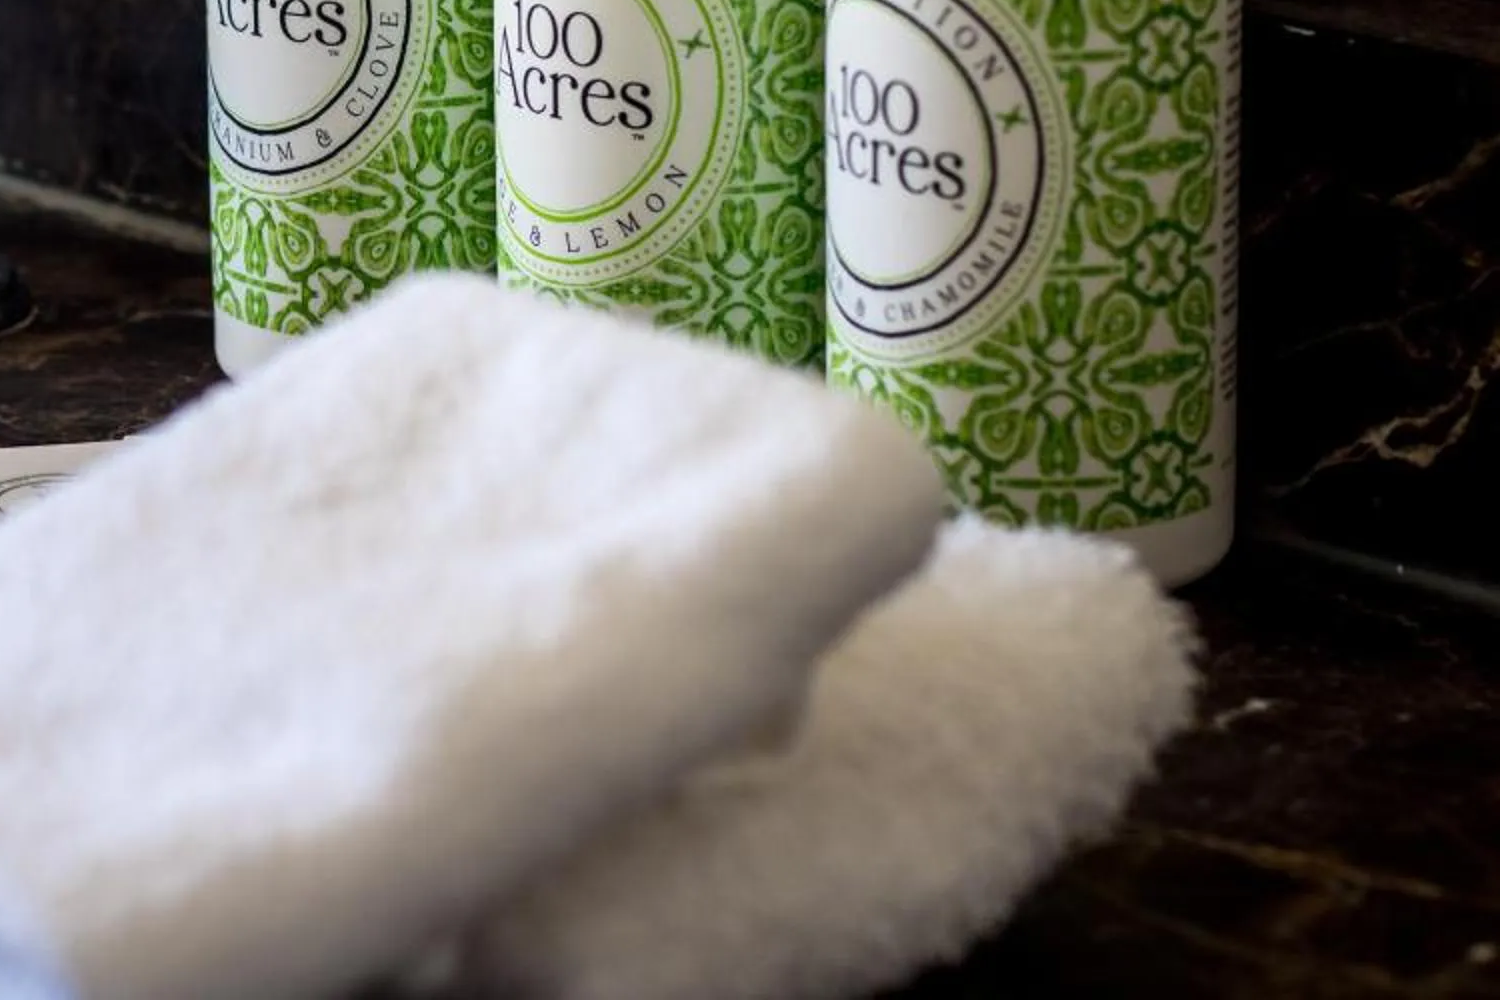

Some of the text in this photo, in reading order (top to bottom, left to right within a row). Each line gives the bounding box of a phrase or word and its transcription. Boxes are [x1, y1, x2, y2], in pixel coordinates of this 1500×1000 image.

[315, 127, 332, 148] &
[348, 11, 398, 117] CLOVE
[496, 26, 654, 130] Acres
[840, 65, 919, 136] 100
[565, 164, 688, 252] LEMON
[884, 202, 1024, 322] CHAMOMILE
